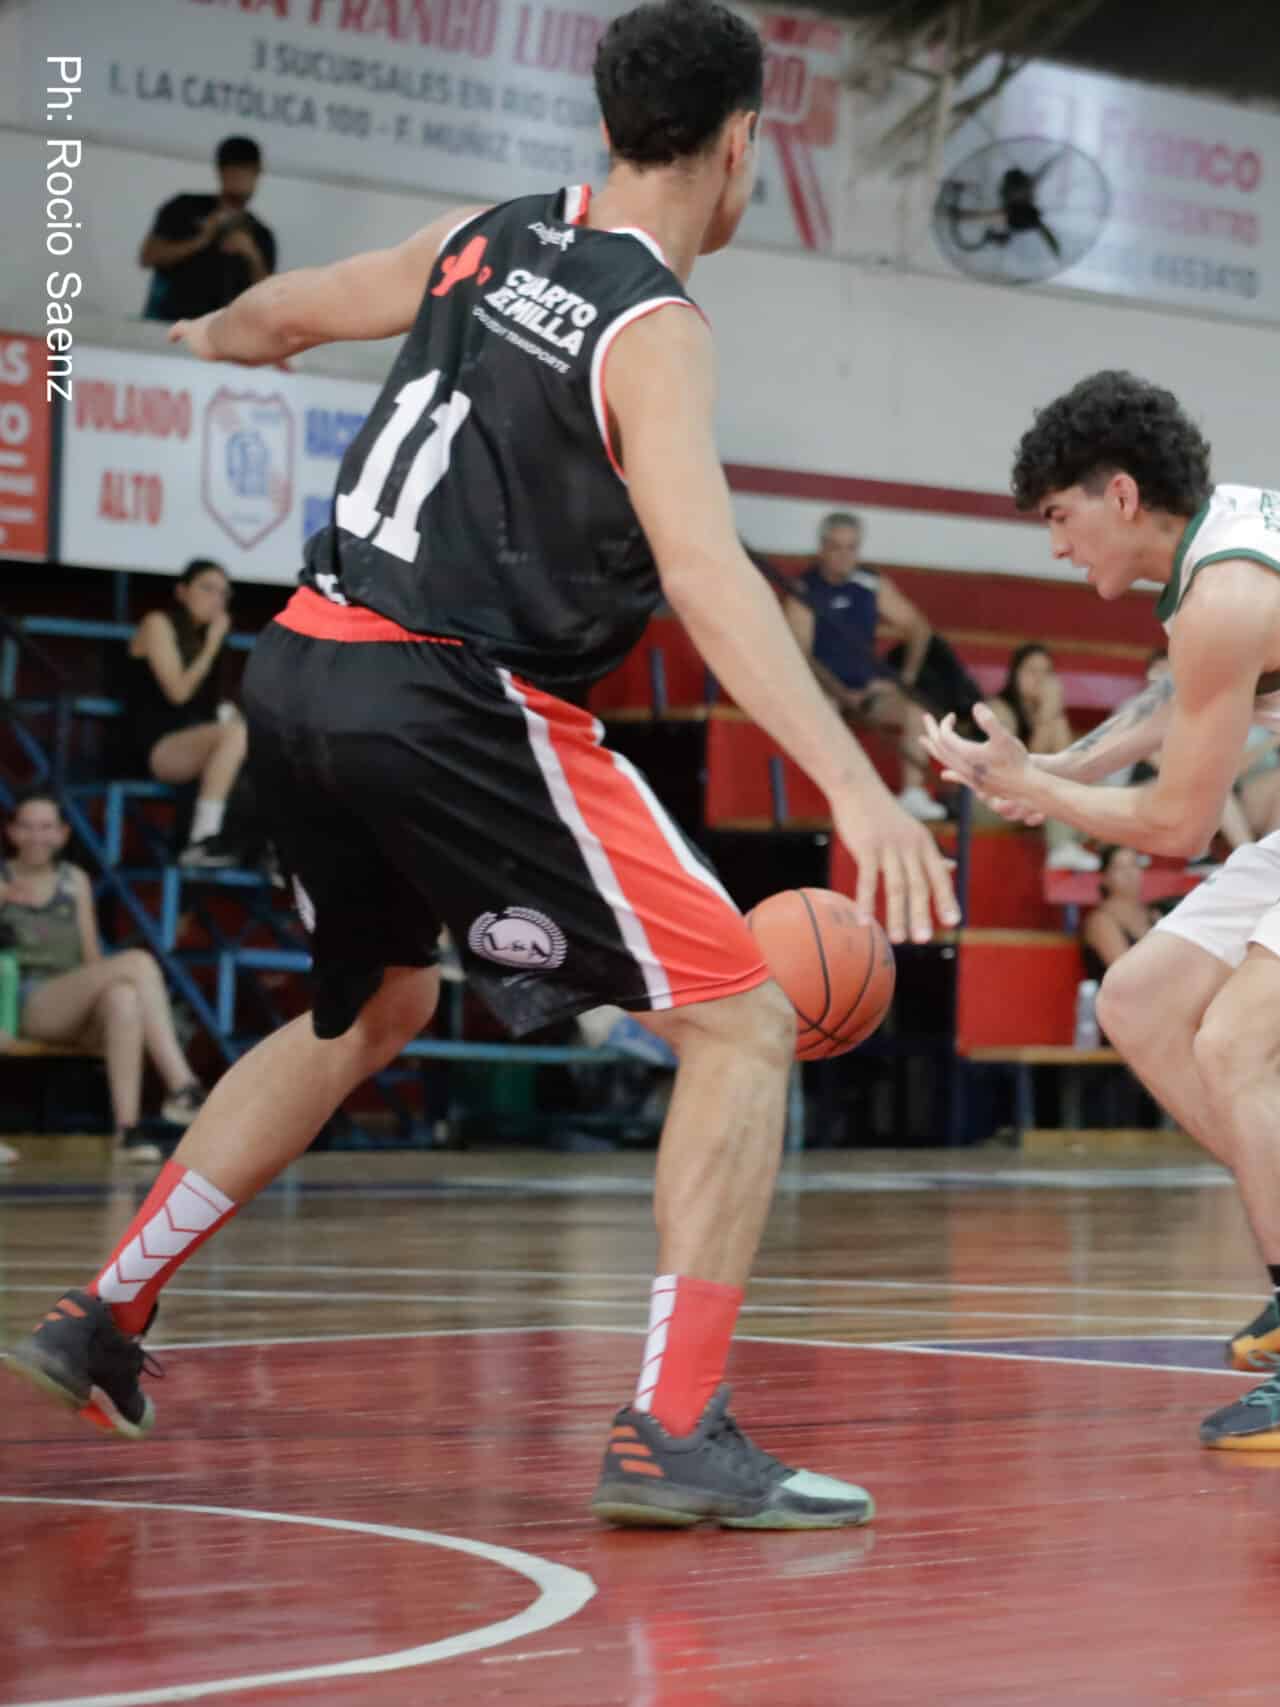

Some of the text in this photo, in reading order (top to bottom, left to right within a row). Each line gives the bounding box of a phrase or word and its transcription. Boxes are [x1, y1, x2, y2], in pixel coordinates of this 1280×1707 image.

[135, 67, 174, 103] LA
[275, 43, 451, 104] SUCURSALES
[504, 268, 599, 329] CARTO
[335, 368, 472, 564] 11
[98, 469, 164, 527] ALTO
